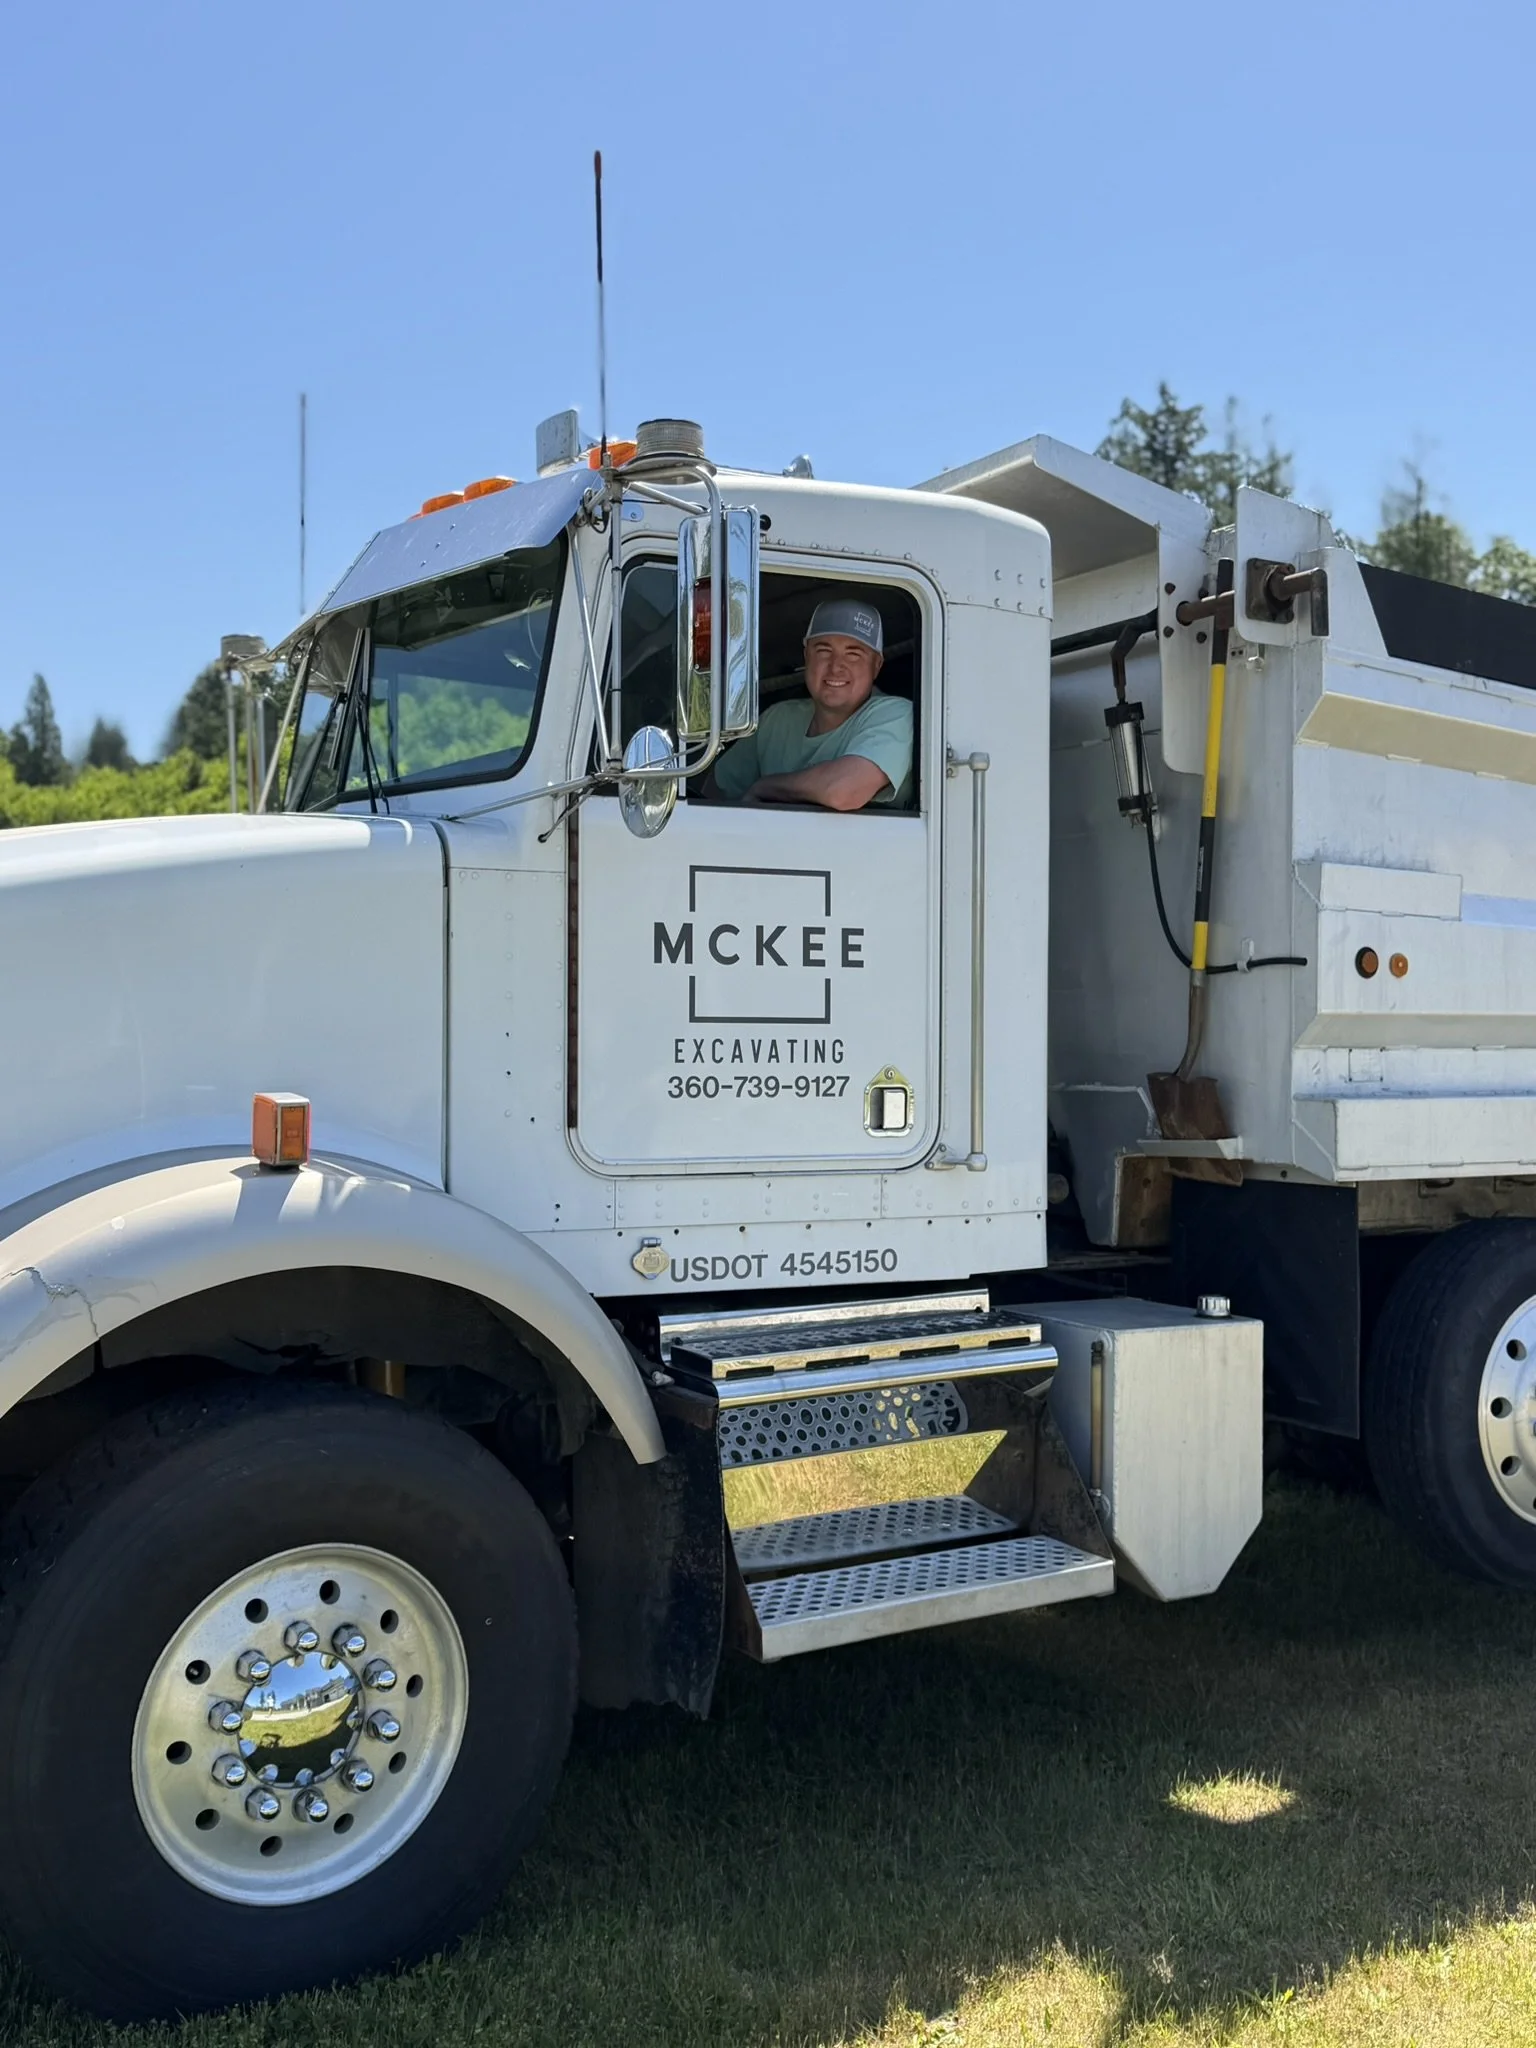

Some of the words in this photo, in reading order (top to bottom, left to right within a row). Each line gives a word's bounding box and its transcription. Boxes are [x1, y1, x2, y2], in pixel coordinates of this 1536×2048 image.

[653, 922, 865, 968] MCKEE
[674, 1038, 844, 1064] EXCAVATING
[667, 1075, 850, 1099] 360-739-9127
[670, 1254, 768, 1283] USDOT
[779, 1248, 898, 1277] 4545150
